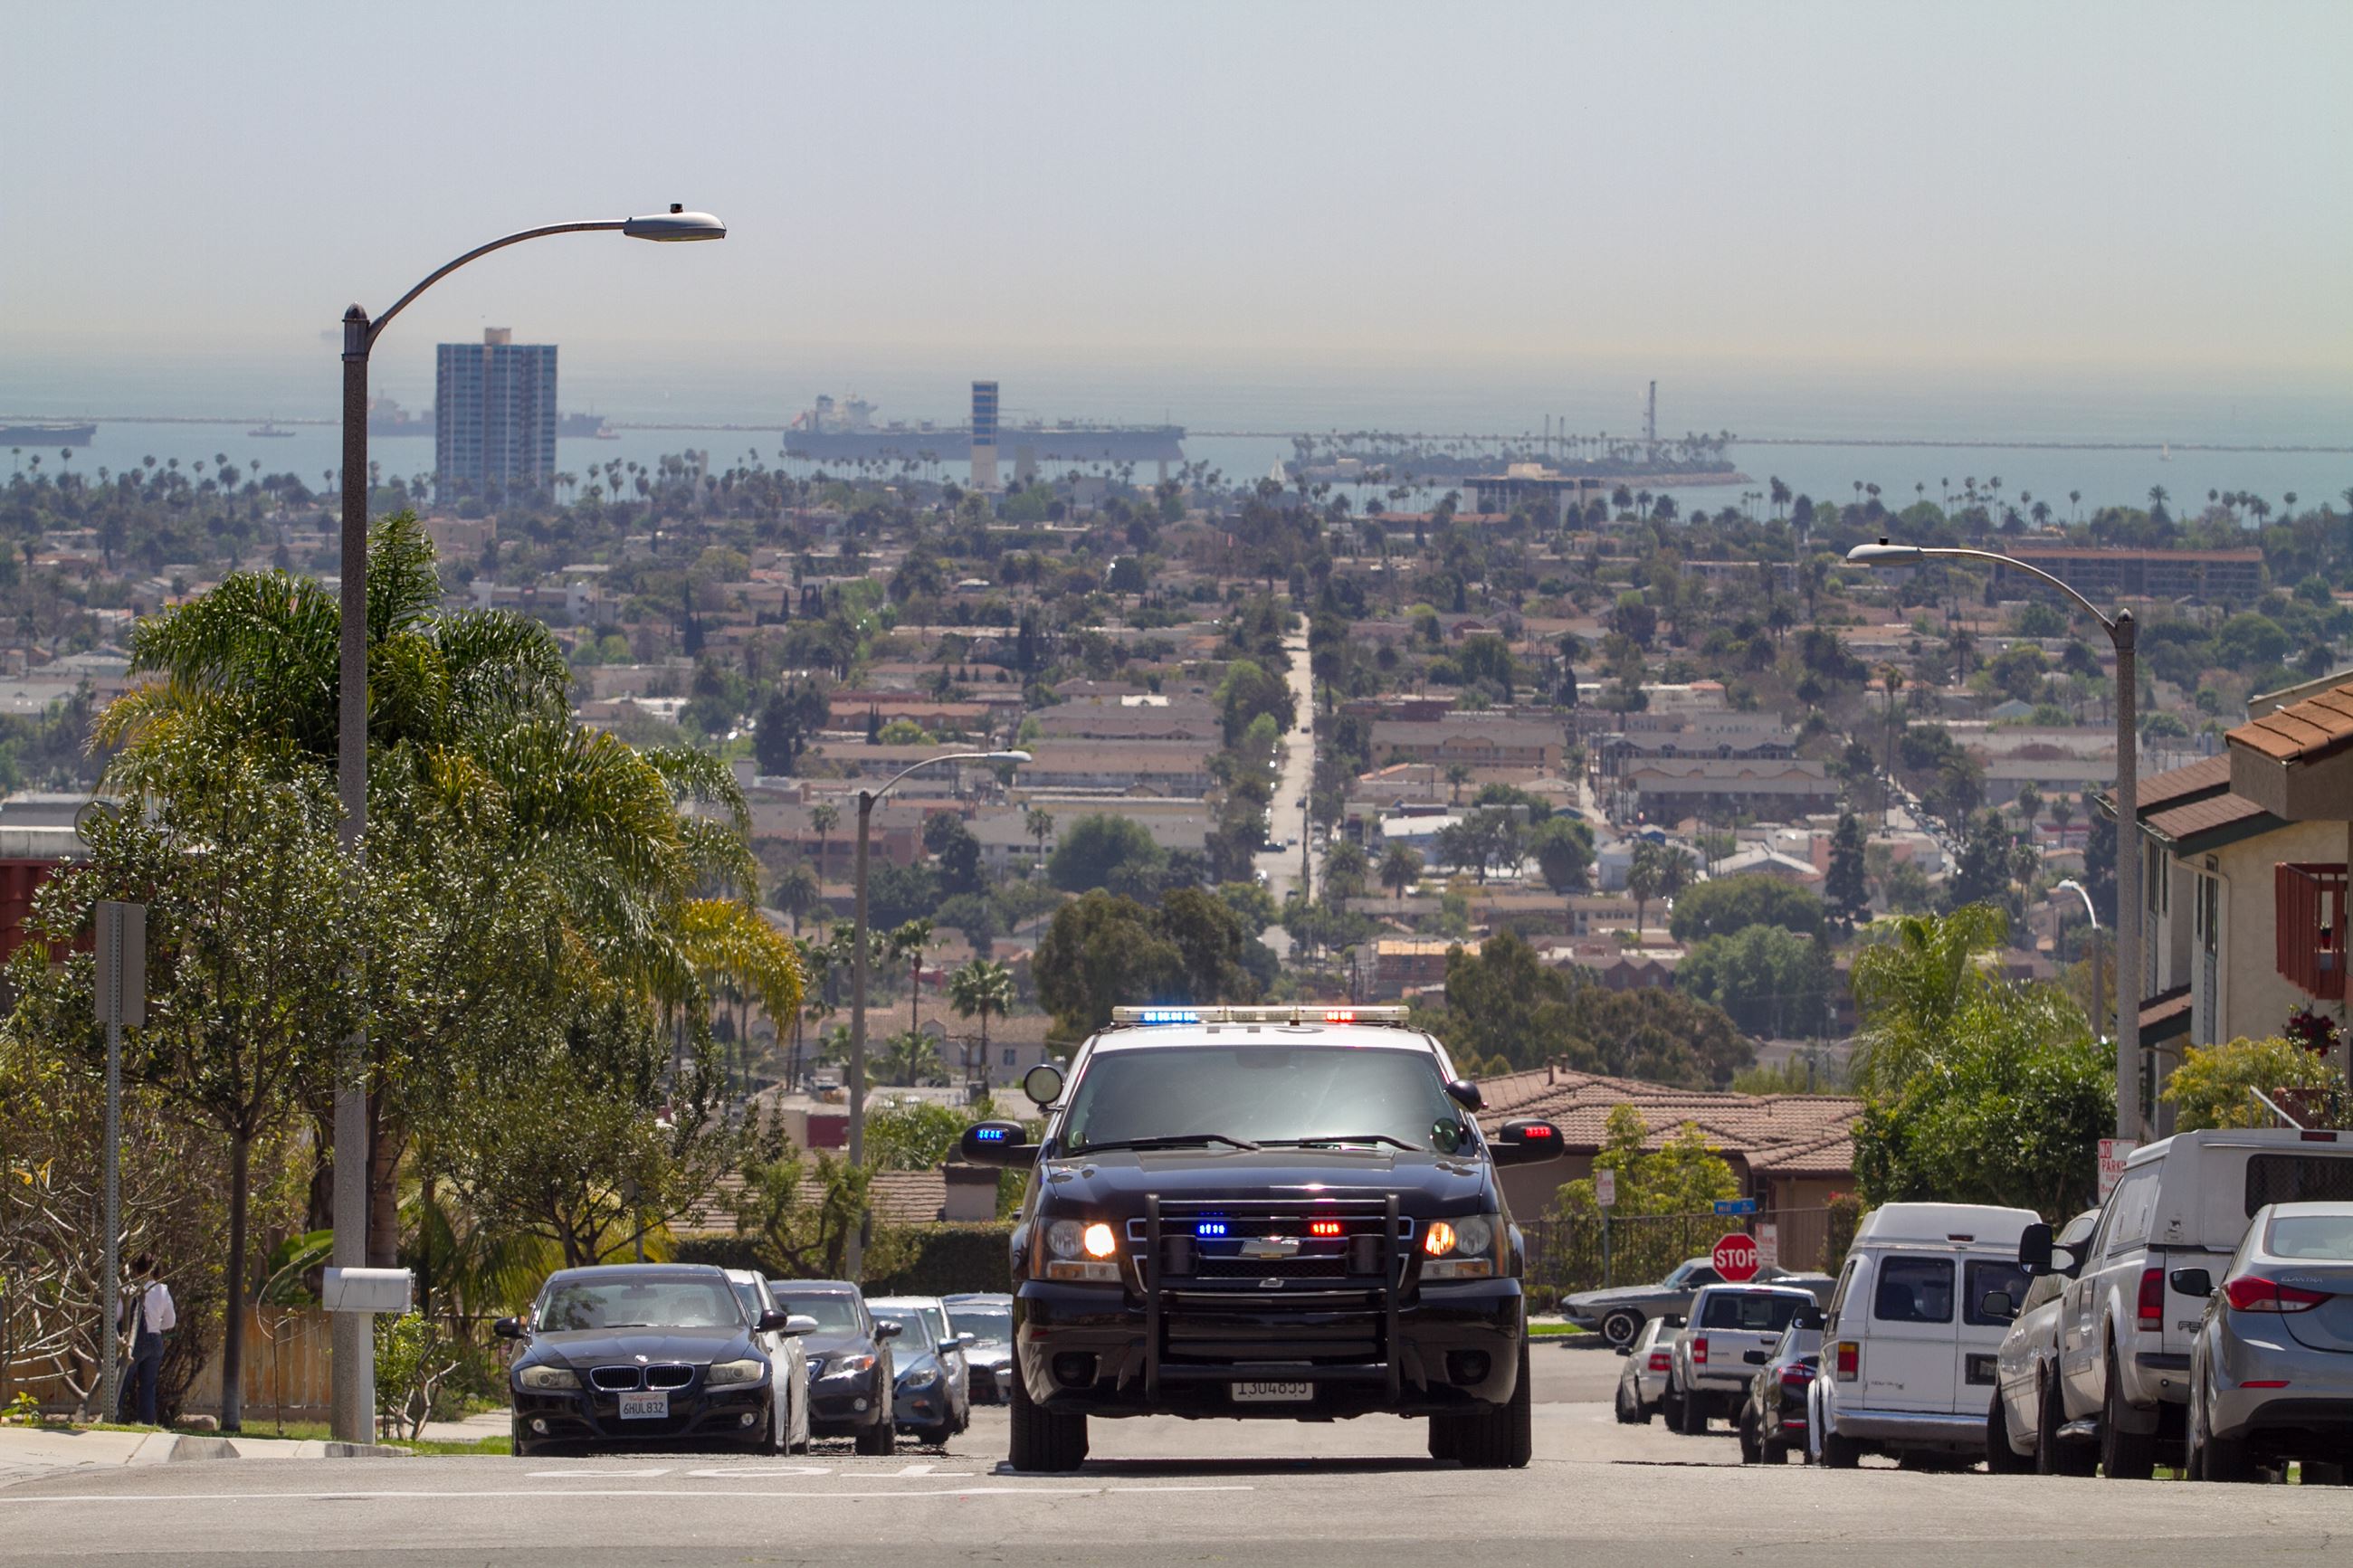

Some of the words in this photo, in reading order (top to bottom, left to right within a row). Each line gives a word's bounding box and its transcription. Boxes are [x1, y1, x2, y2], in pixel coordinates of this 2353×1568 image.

[2100, 1141, 2112, 1158] NO
[1716, 1249, 1758, 1269] STOP
[624, 1402, 663, 1414] 6HUL832
